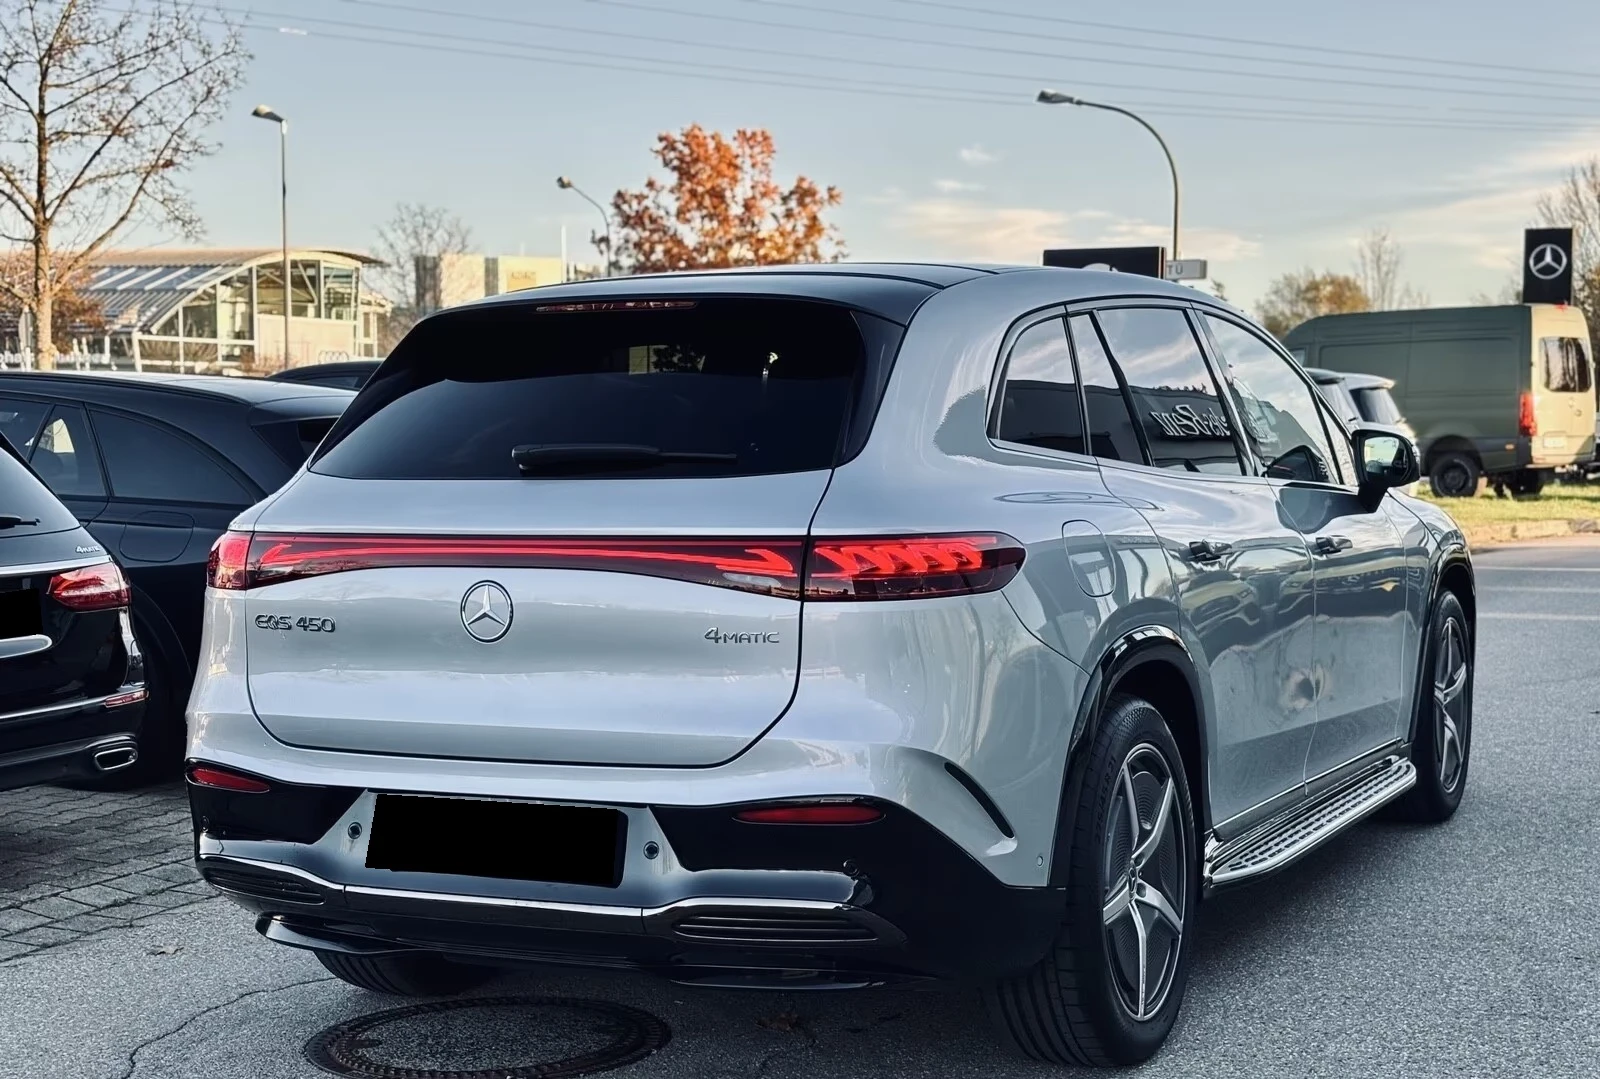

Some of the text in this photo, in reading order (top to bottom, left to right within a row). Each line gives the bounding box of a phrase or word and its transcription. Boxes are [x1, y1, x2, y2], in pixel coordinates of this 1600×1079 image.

[255, 614, 335, 632] EQS 450
[704, 627, 780, 643] 4MATIC
